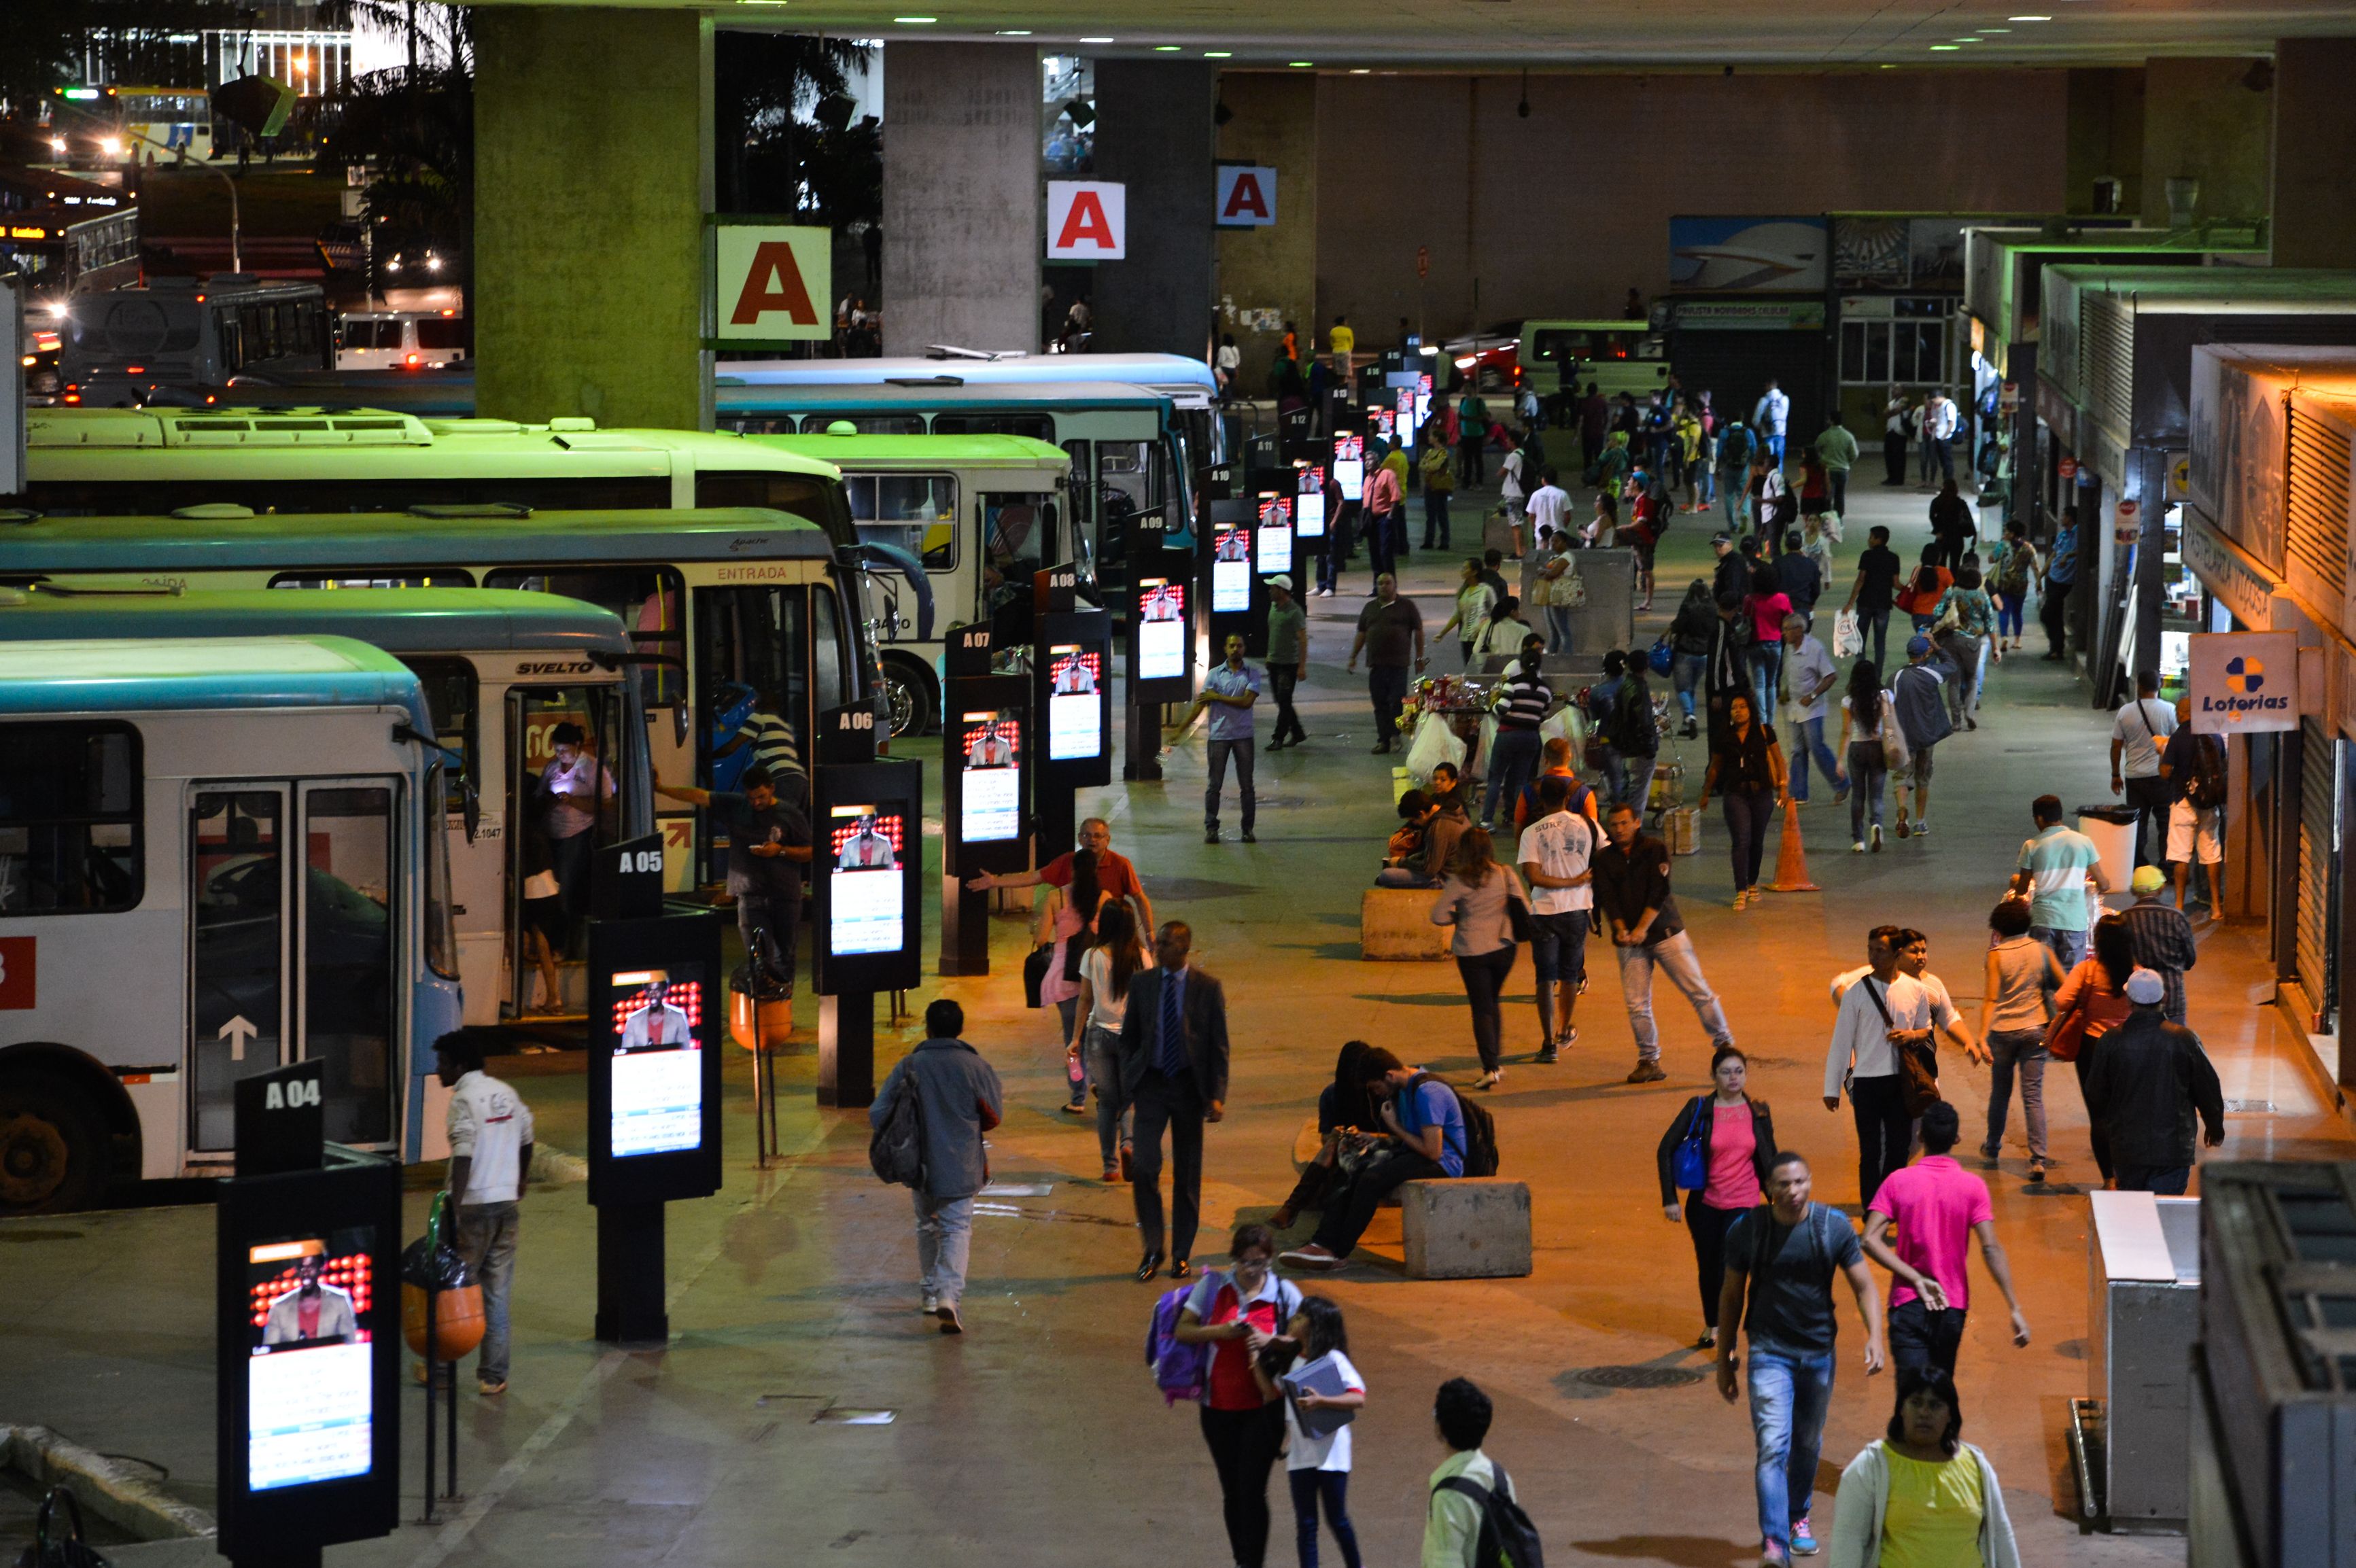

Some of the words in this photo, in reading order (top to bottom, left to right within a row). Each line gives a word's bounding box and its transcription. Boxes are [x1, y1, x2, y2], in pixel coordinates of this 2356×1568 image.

[1224, 173, 1268, 217] A
[1056, 191, 1116, 249] A
[730, 241, 819, 326] A
[1333, 389, 1338, 398] A
[1339, 389, 1347, 398] 13
[1292, 416, 1298, 424] A
[1298, 415, 1306, 423] 12
[1258, 442, 1264, 451] A
[1264, 442, 1272, 450] 11
[1211, 470, 1219, 481] A
[1219, 470, 1230, 481] 10
[1141, 517, 1147, 529] A
[1149, 517, 1163, 529] 09
[718, 567, 786, 580] ENTRADA
[1050, 574, 1058, 587] A
[1060, 574, 1075, 587] 08
[963, 633, 972, 647] A
[974, 632, 990, 647] 07
[516, 663, 594, 675] SVELTO
[2202, 695, 2288, 712] Loterias
[839, 713, 850, 729] A
[852, 712, 873, 729] 06
[619, 852, 634, 873] A
[636, 851, 662, 872] 05
[265, 1082, 284, 1109] A
[287, 1079, 322, 1108] 04
